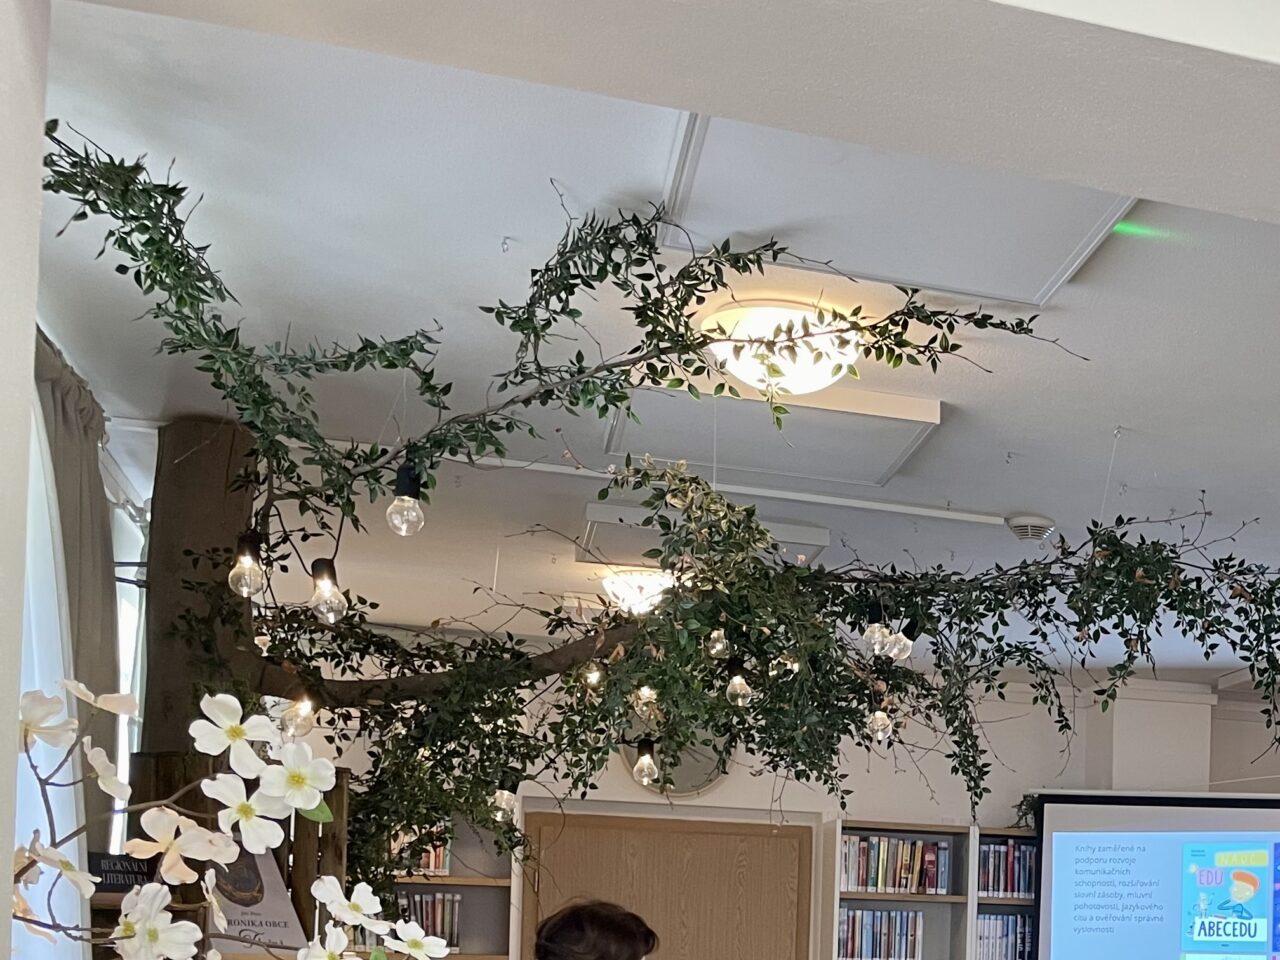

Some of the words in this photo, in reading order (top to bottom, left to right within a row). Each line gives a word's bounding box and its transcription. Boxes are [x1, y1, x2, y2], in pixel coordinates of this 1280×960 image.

[1075, 845, 1096, 854] Knihy
[1074, 857, 1107, 865] podporu
[1109, 857, 1136, 866] rozvoje
[102, 873, 148, 885] LITERATURA
[1199, 870, 1224, 885] EDU
[1121, 903, 1164, 912] jazykového
[227, 919, 263, 929] RONIKA
[264, 920, 289, 929] OBCE
[1198, 921, 1257, 938] ABECEDU
